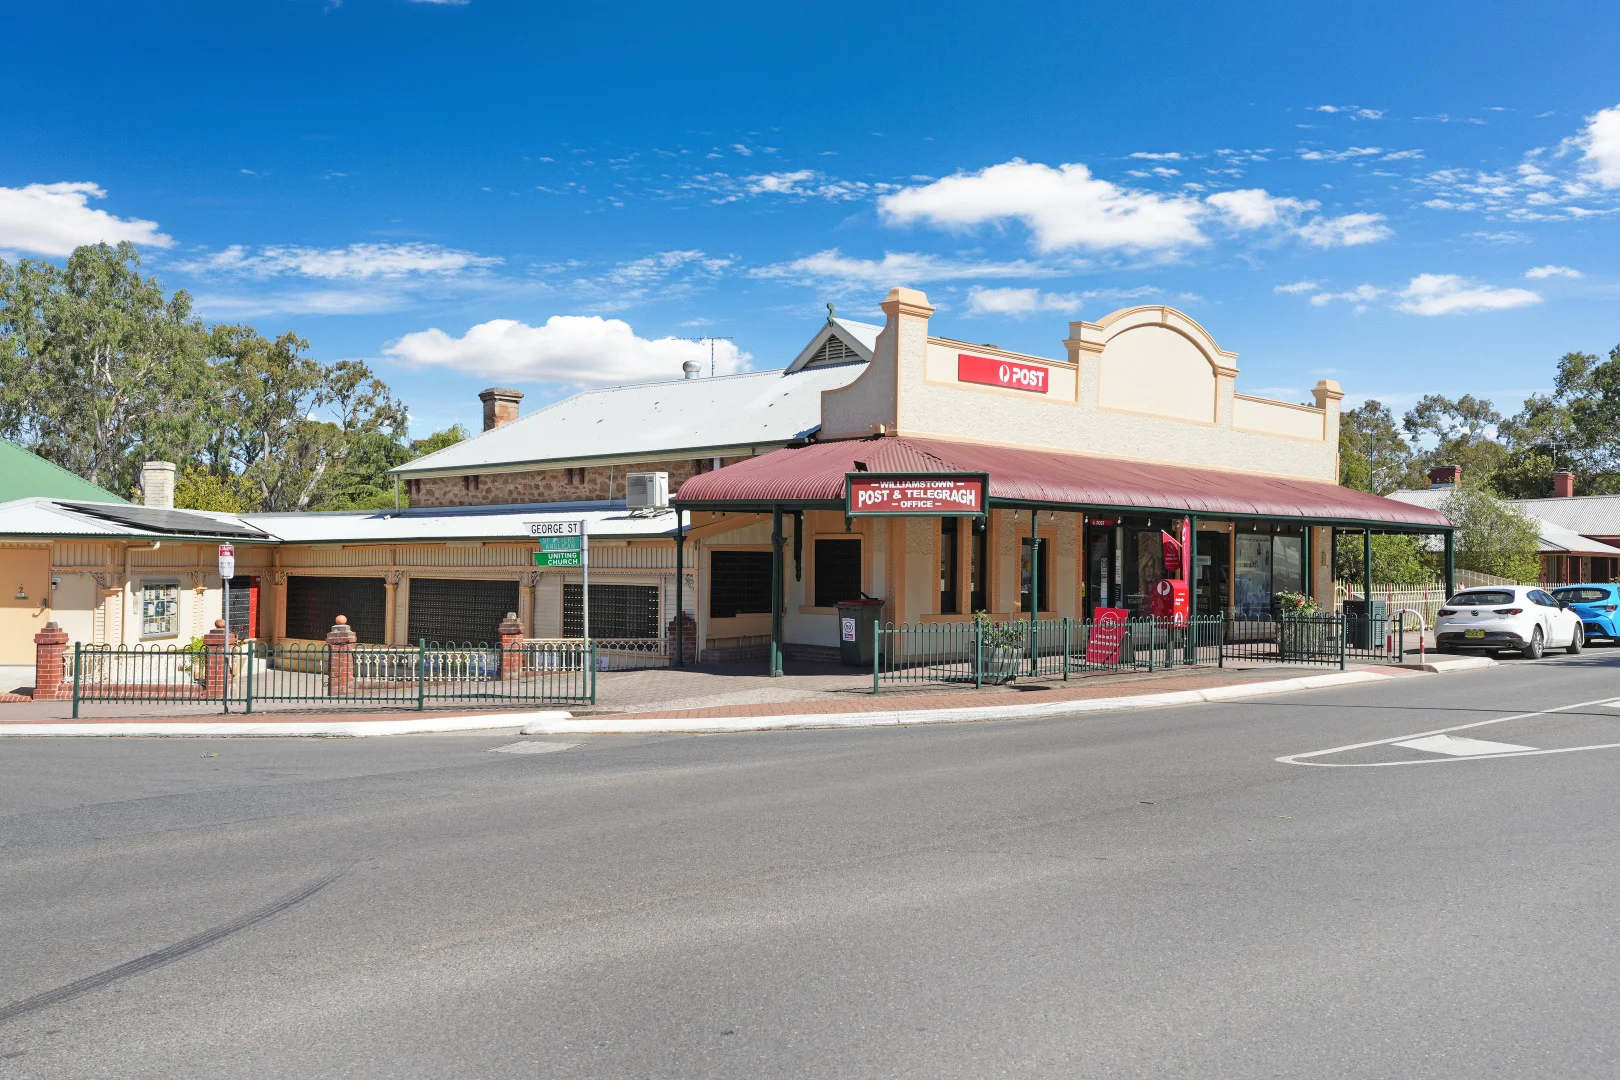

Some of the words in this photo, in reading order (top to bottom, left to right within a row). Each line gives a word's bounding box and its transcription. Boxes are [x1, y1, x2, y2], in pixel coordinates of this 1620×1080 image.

[1012, 367, 1045, 387] POST
[880, 480, 954, 488] WILLIAMSTOWN
[858, 490, 889, 507] POST
[892, 490, 902, 499] &
[905, 489, 976, 506] TELEGRAGH
[900, 500, 933, 508] OFFICE
[531, 523, 564, 534] GEORGE
[567, 523, 578, 533] ST
